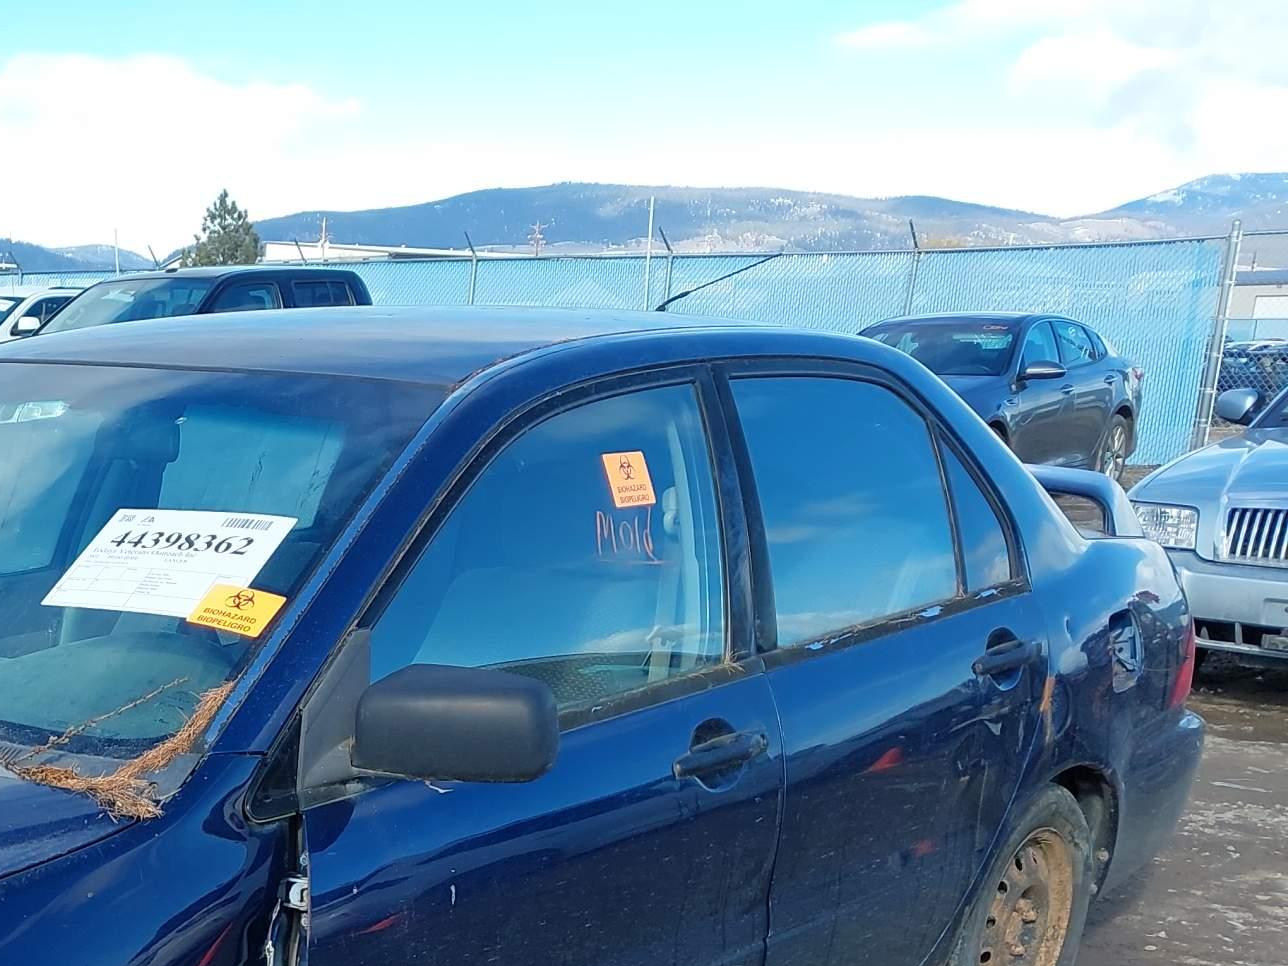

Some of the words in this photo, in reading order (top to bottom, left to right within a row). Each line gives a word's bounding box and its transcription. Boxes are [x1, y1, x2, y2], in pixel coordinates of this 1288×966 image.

[617, 484, 647, 493] BIOHAZARD
[110, 530, 255, 556] 44398362
[197, 614, 251, 632] BIOPELIGRO
[203, 607, 256, 625] BIOHAZARD
